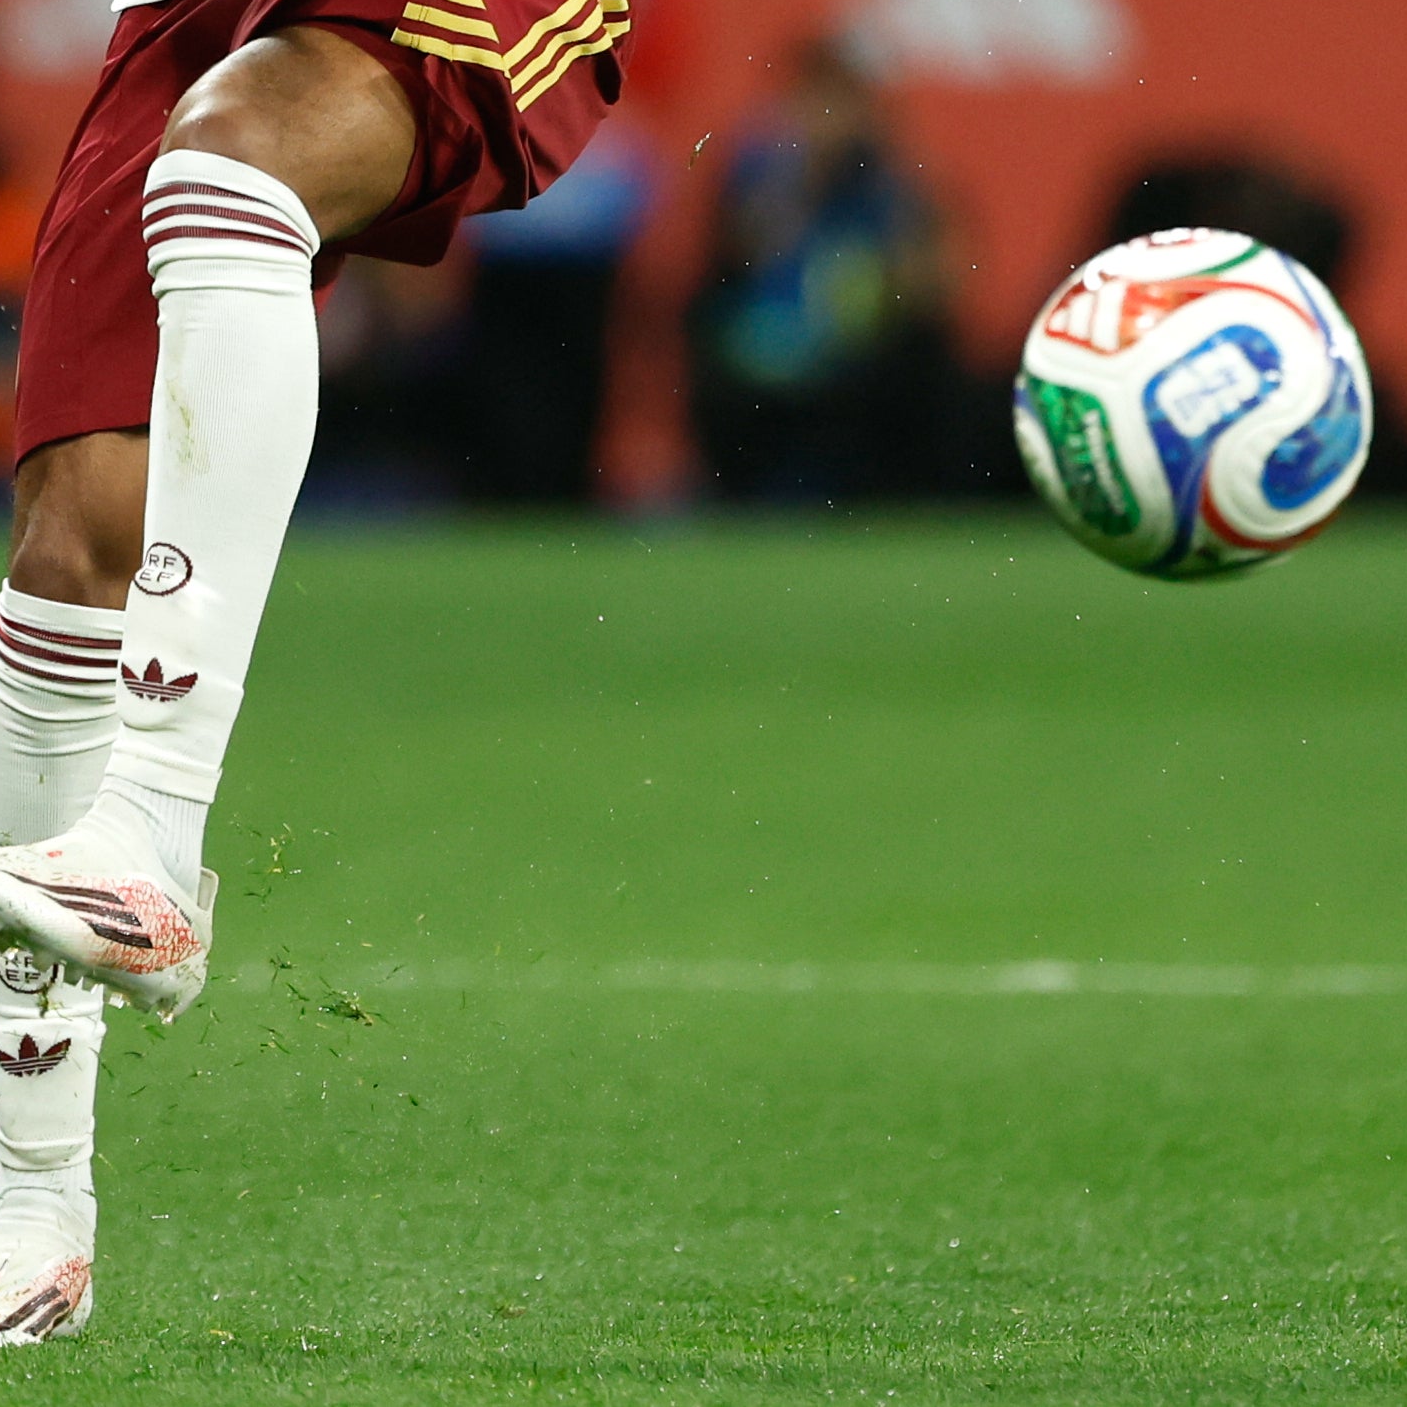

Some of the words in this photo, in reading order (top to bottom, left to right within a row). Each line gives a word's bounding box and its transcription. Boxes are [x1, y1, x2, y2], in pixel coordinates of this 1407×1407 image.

[149, 553, 177, 568] RF
[139, 568, 175, 582] EF
[6, 969, 42, 984] EF
